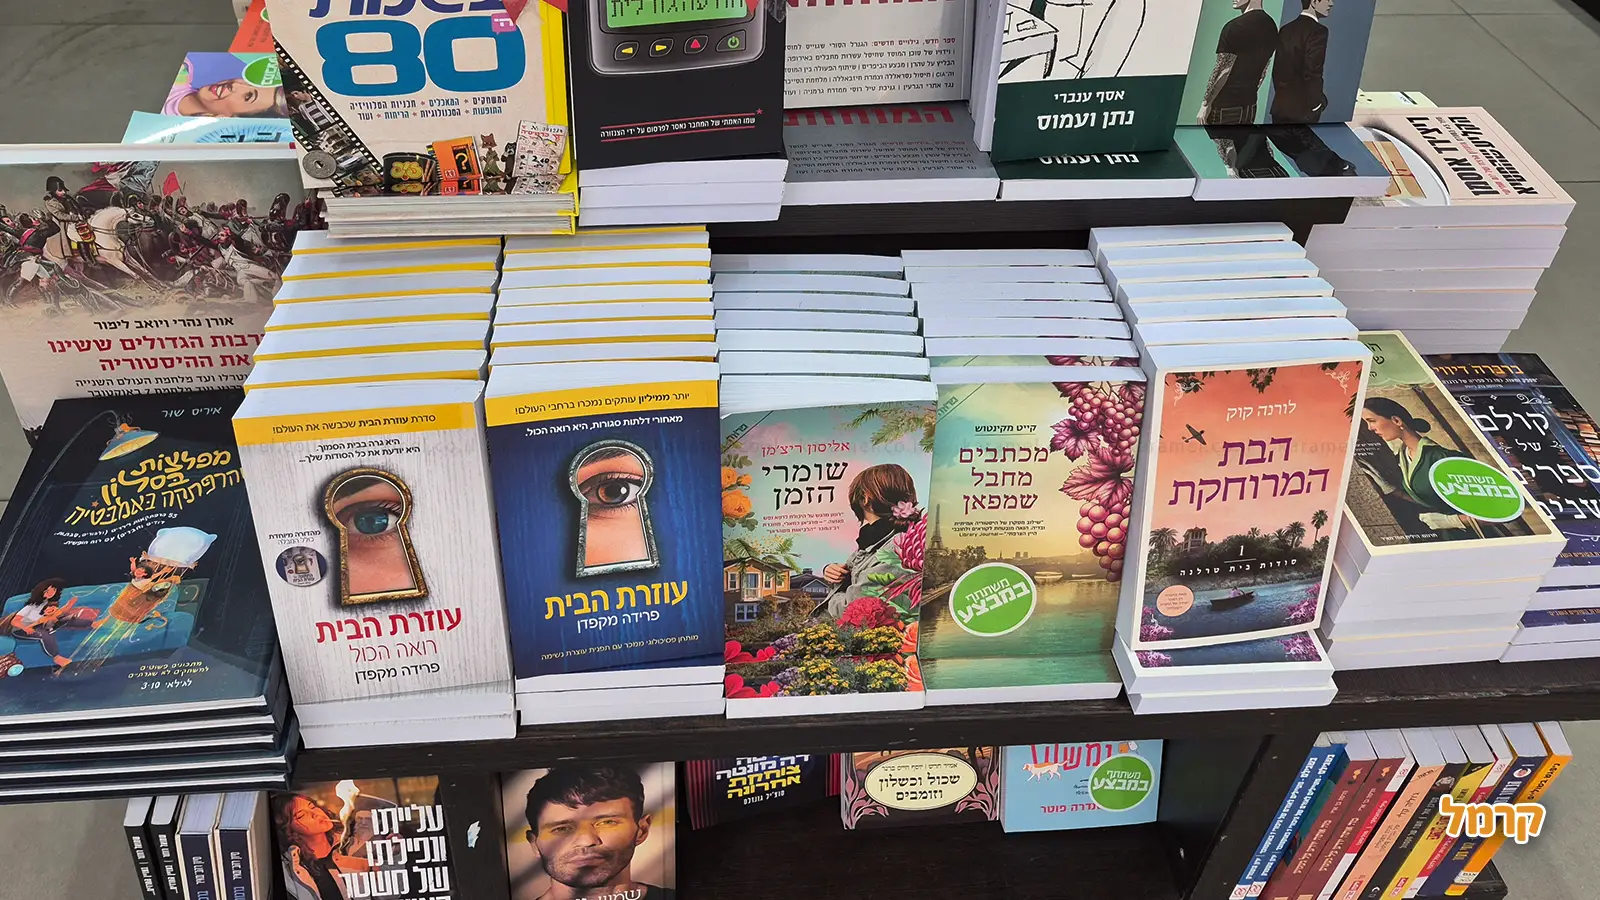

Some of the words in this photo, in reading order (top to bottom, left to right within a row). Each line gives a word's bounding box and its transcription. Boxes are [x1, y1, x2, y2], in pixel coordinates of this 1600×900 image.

[316, 16, 526, 97] 80
[1054, 92, 1093, 104] ענברי
[1096, 90, 1126, 104] אסף
[688, 120, 710, 129] המחבר
[710, 118, 720, 127] של
[721, 118, 742, 127] האמתי
[742, 117, 756, 125] שמו
[1036, 112, 1097, 131] ועמוס
[1102, 110, 1136, 130] נתן
[626, 128, 634, 136] ידי
[636, 125, 646, 135] על
[646, 123, 669, 133] לפרסום
[671, 122, 687, 131] נאסר
[600, 128, 626, 138] הצנזורה
[94, 320, 130, 332] לימור
[135, 319, 169, 331] ויואב
[174, 318, 202, 330] נהרי
[206, 316, 234, 329] אורן
[48, 338, 112, 354] ששינו
[120, 334, 204, 352] הגדולים
[99, 355, 214, 372] ההיסטוריה
[220, 352, 251, 368] את
[1472, 365, 1525, 375] ברברה
[75, 378, 114, 389] השנייה
[116, 376, 152, 387] העולם
[155, 376, 192, 388] מלחמת
[196, 375, 214, 385] ועד
[604, 396, 636, 406] עותקים
[638, 394, 670, 404] ממיליון
[672, 392, 690, 400] יותר
[514, 404, 546, 416] העולם!
[548, 402, 576, 412] ברחבי
[577, 399, 603, 409] נמכרו
[1257, 398, 1297, 418] לורנה
[162, 409, 185, 418] שור
[192, 406, 222, 416] איריס
[1226, 406, 1254, 422] קוק
[358, 418, 382, 429] הבית
[382, 416, 409, 427] עוזרת
[410, 412, 437, 424] סדרת
[622, 416, 652, 427] דלתות
[652, 414, 684, 424] מאחורי
[1470, 405, 1550, 436] קולם
[272, 423, 304, 435] העולם!
[306, 423, 320, 432] את
[322, 420, 356, 432] שכבשה
[550, 424, 572, 434] רואה
[572, 423, 589, 432] היא
[590, 419, 622, 432] סגורות,
[974, 425, 1014, 434] מקינטוש
[1016, 424, 1037, 433] קייט
[524, 427, 549, 441] הכול.
[316, 442, 346, 454] הסמוך.
[348, 441, 368, 452] בבית
[369, 440, 384, 449] גרה
[388, 438, 401, 446] היא
[808, 440, 850, 455] אליסון
[1515, 438, 1542, 452] של
[356, 448, 366, 460] כל
[368, 449, 381, 458] את
[382, 447, 404, 458] יודעת
[406, 446, 420, 454] היא
[762, 444, 803, 458] ריצ'מן
[959, 446, 1049, 464] מכתבים
[1218, 436, 1293, 467] הבת
[330, 451, 355, 462] הסודות
[130, 450, 232, 476] מפלצות
[762, 461, 849, 484] שומרי
[970, 466, 1033, 488] מחבל
[1446, 473, 1496, 484] משתתף
[162, 469, 240, 511] הרפתקה
[1168, 468, 1330, 513] המרוחקת
[1437, 480, 1518, 499] במבצע
[773, 485, 836, 511] הזמן
[64, 493, 157, 526] באמבטיה
[962, 493, 1038, 516] שמפאן
[268, 532, 294, 540] מיוחדת
[294, 530, 321, 538] מהדורה
[1239, 545, 1245, 556] 1
[1229, 564, 1251, 572] בית
[1260, 558, 1297, 569] סודות
[1180, 567, 1220, 576] טרלנה
[616, 580, 689, 610] עוזרת
[965, 577, 1010, 604] משתתף
[544, 589, 610, 620] הבית
[957, 581, 1030, 624] במבצע
[388, 607, 461, 636] עוזרת
[622, 610, 661, 625] פרידה
[315, 616, 383, 644] הבית
[576, 614, 619, 634] מקפדן
[624, 640, 645, 650] ממכר
[646, 637, 677, 648] פסיכולוגי
[678, 634, 700, 644] מותחן
[348, 644, 391, 663] הכול
[396, 639, 438, 659] רואה
[566, 648, 588, 659] עוצרת
[588, 645, 611, 656] תפנית
[612, 643, 623, 652] עם
[540, 652, 565, 662] נשימה
[401, 662, 441, 677] פרידה
[355, 667, 397, 685] מקפדן
[728, 764, 802, 788] צוחקת
[927, 772, 960, 786] שכול
[1106, 770, 1142, 783] משתתף
[727, 774, 802, 799] אחרונה
[878, 774, 922, 792] וכשלון
[1092, 777, 1150, 794] במבצע
[896, 789, 944, 802] וזומבים
[1040, 805, 1067, 814] פוטר
[370, 804, 444, 836] עלייתו
[366, 836, 448, 868] ונפילתו
[338, 870, 410, 899] משטר
[412, 866, 451, 894] של
